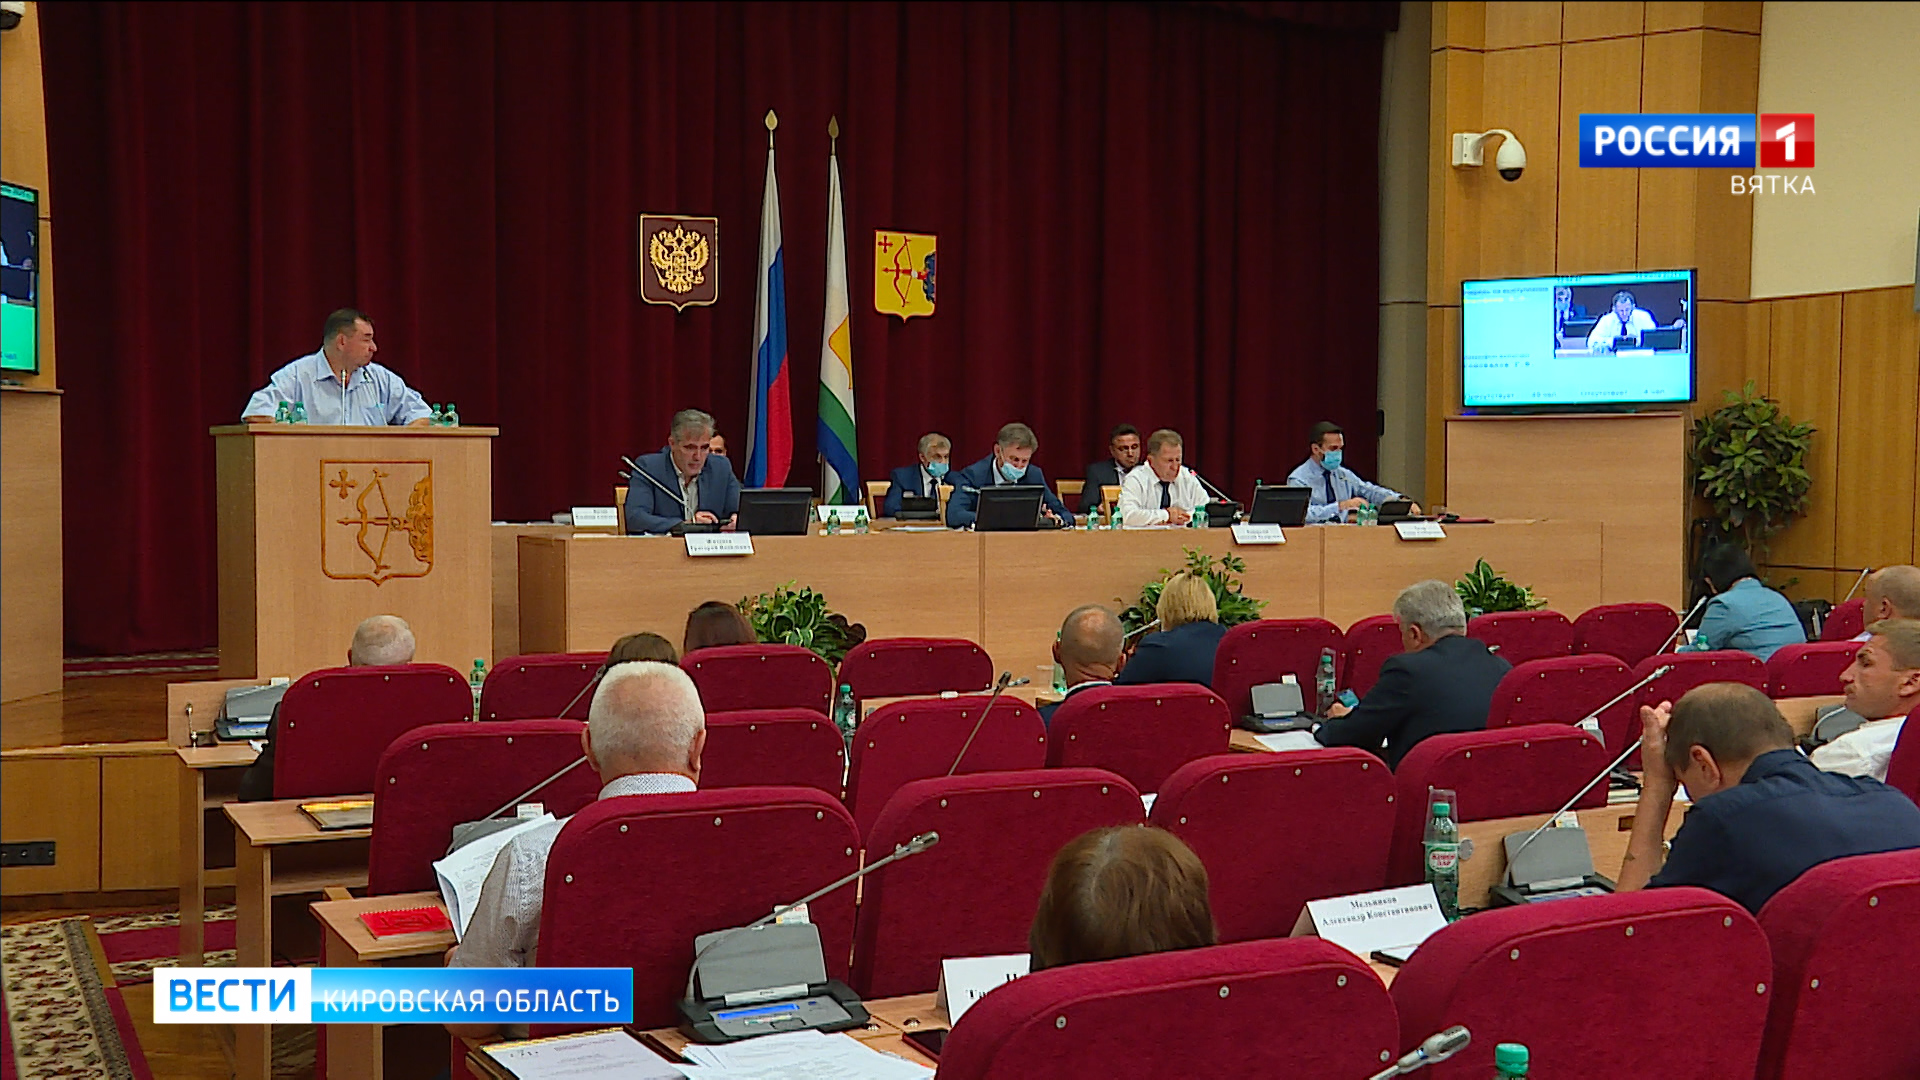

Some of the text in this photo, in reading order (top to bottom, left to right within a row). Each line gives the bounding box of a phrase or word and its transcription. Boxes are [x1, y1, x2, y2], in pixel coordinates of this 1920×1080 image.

[1349, 896, 1398, 910] Мельников
[1321, 903, 1434, 926] Александр Константинович
